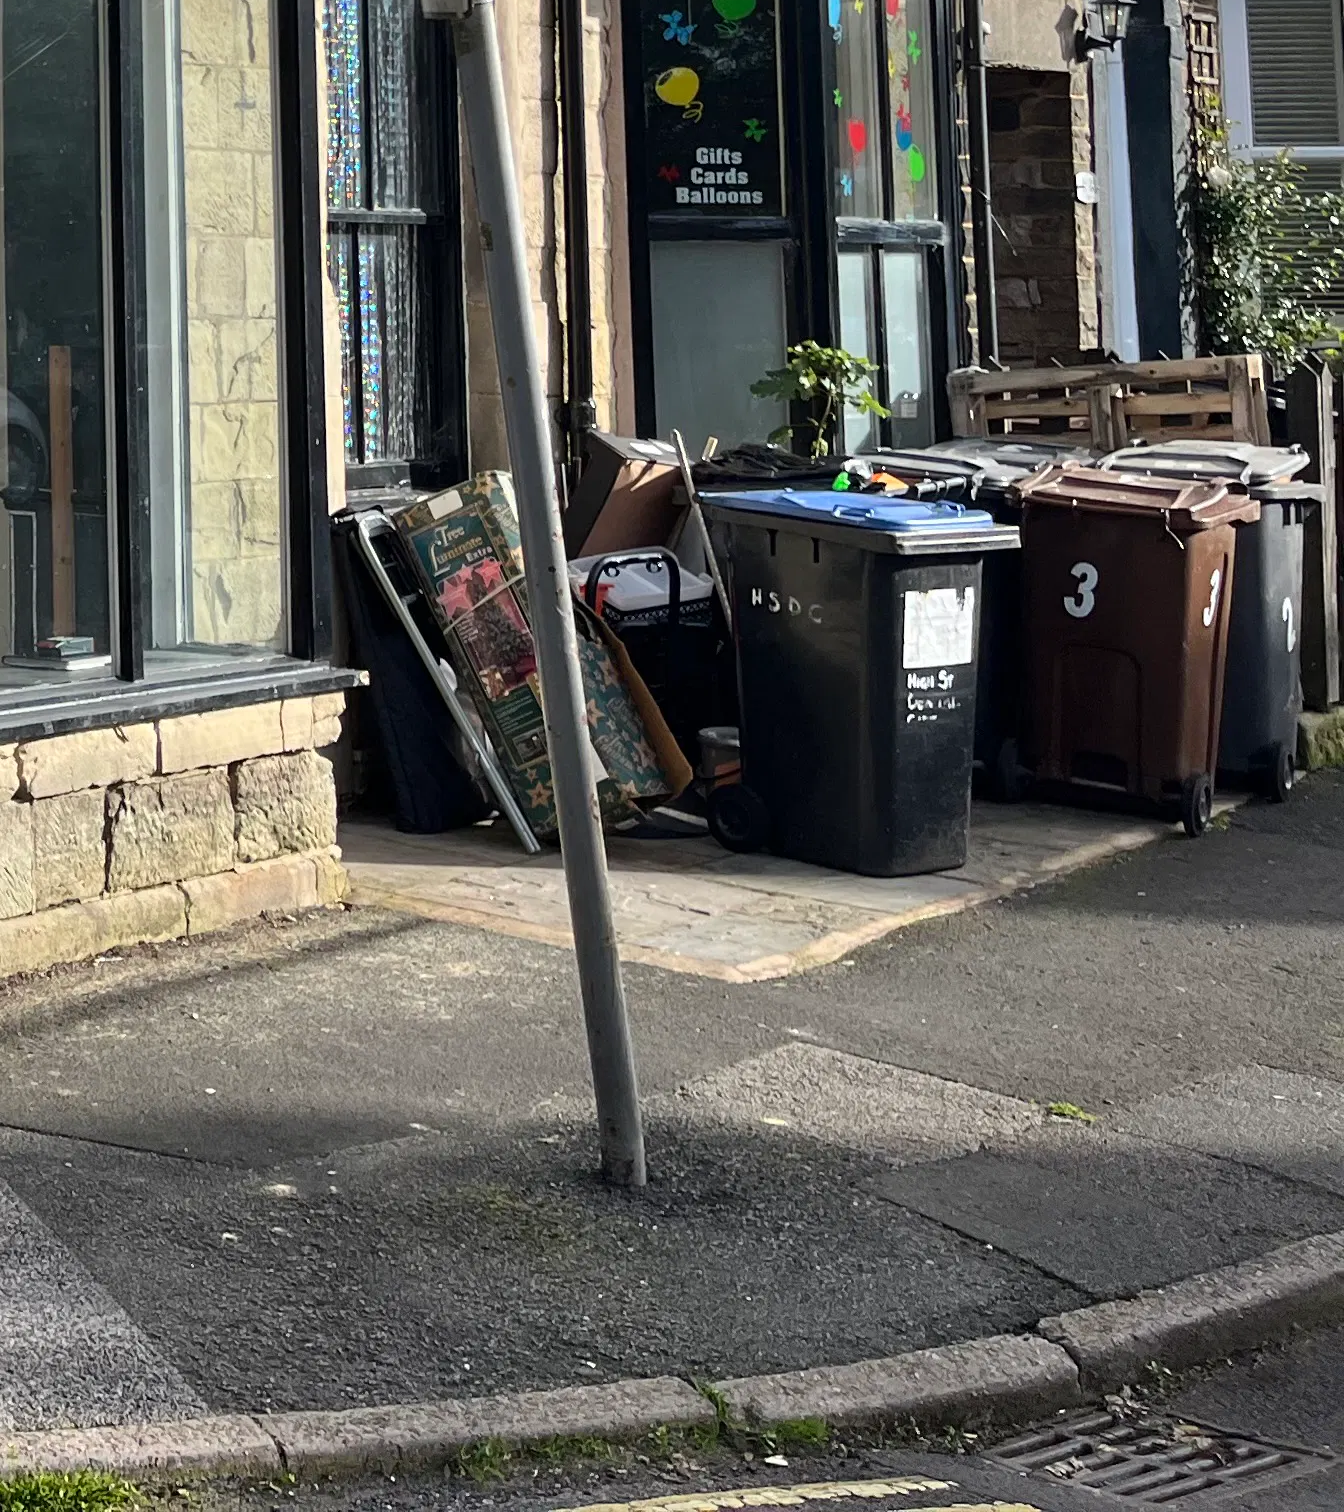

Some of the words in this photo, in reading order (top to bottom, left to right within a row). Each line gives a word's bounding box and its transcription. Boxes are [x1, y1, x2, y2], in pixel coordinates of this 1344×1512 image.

[696, 147, 743, 165] Gifts
[690, 167, 749, 185] Cards
[675, 187, 764, 205] Balloons
[1064, 561, 1099, 618] 3
[1203, 568, 1220, 627] 3
[1282, 596, 1297, 653] 2
